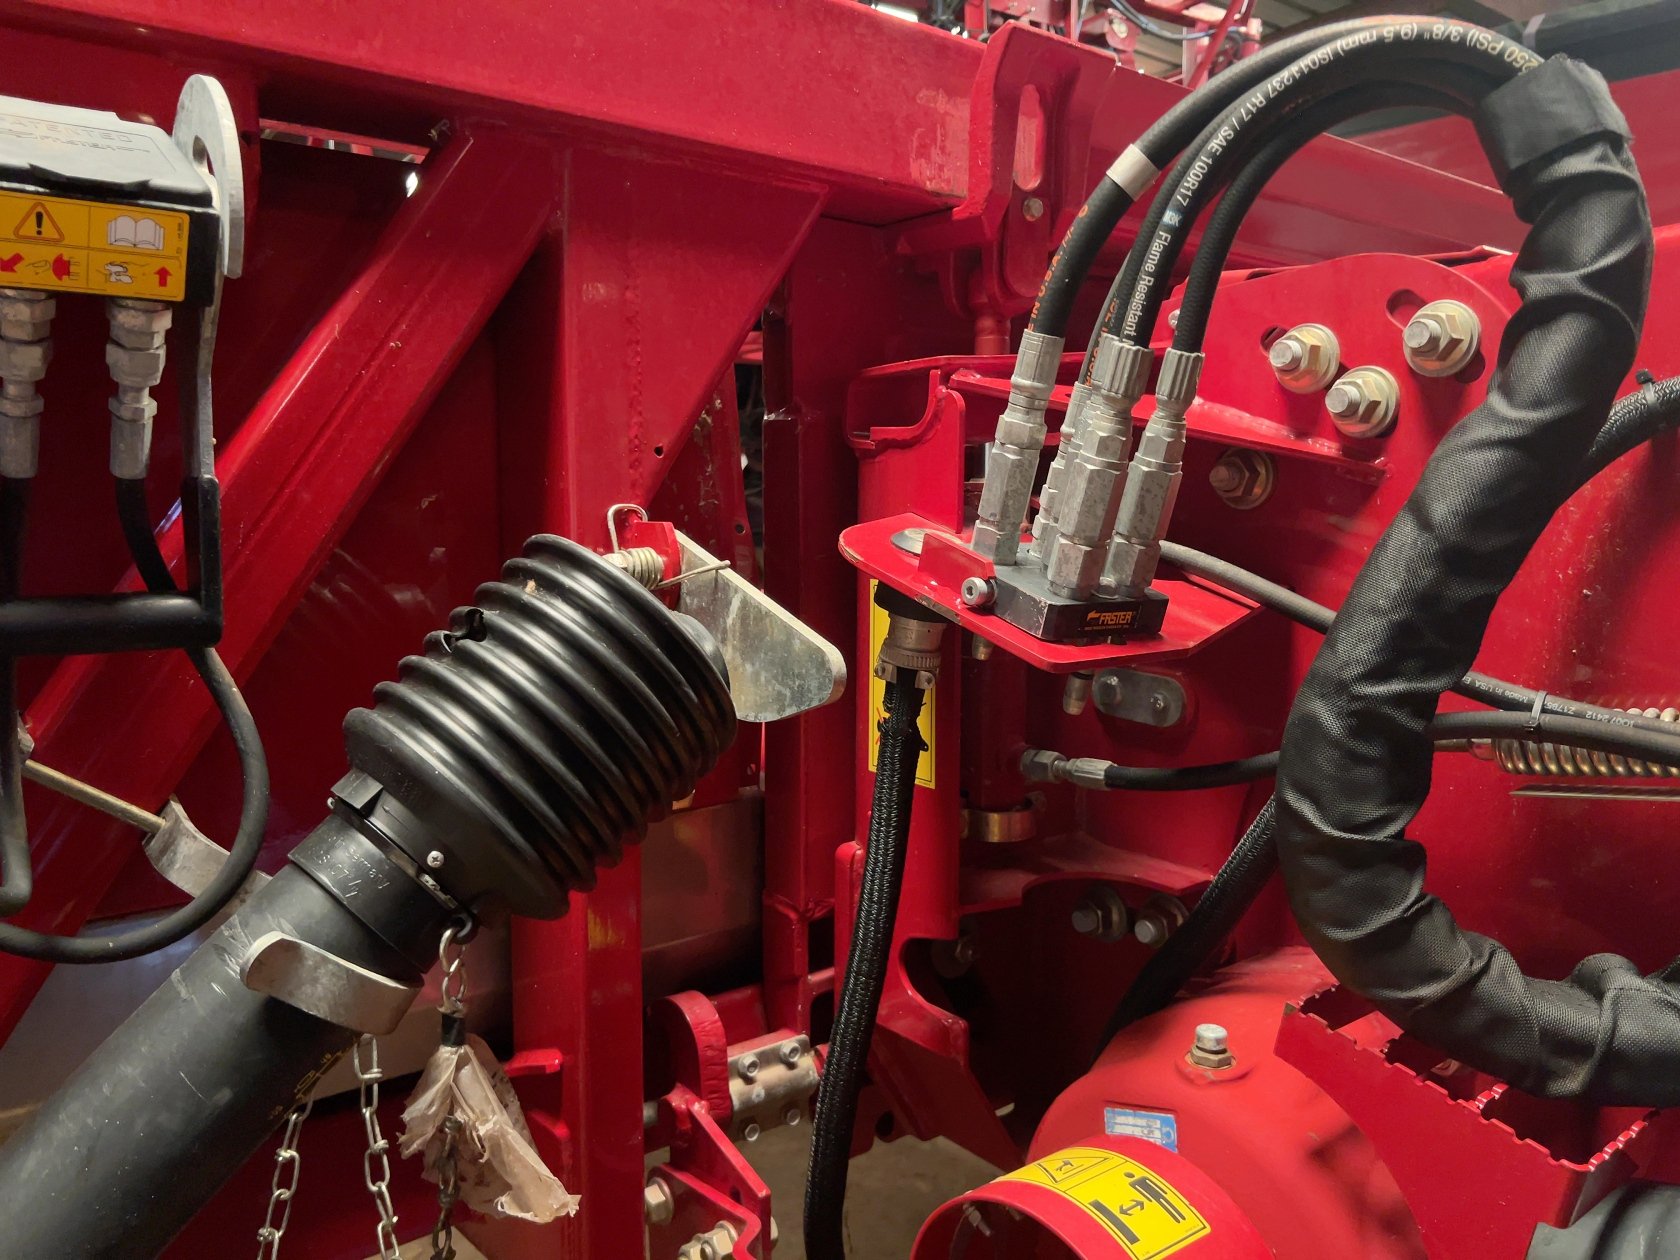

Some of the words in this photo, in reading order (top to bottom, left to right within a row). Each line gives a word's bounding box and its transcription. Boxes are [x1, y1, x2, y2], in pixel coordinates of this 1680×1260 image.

[1337, 30, 1376, 57] mm)
[1383, 22, 1417, 42] (9.5
[1466, 28, 1504, 55] PSI)
[1240, 93, 1266, 122] R17
[1207, 126, 1235, 155] SAE
[1176, 155, 1213, 207] 100R17
[1145, 231, 1171, 272] Flame
[1123, 274, 1154, 336] Resistant
[1474, 678, 1494, 694] USA
[1504, 689, 1529, 704] Made
